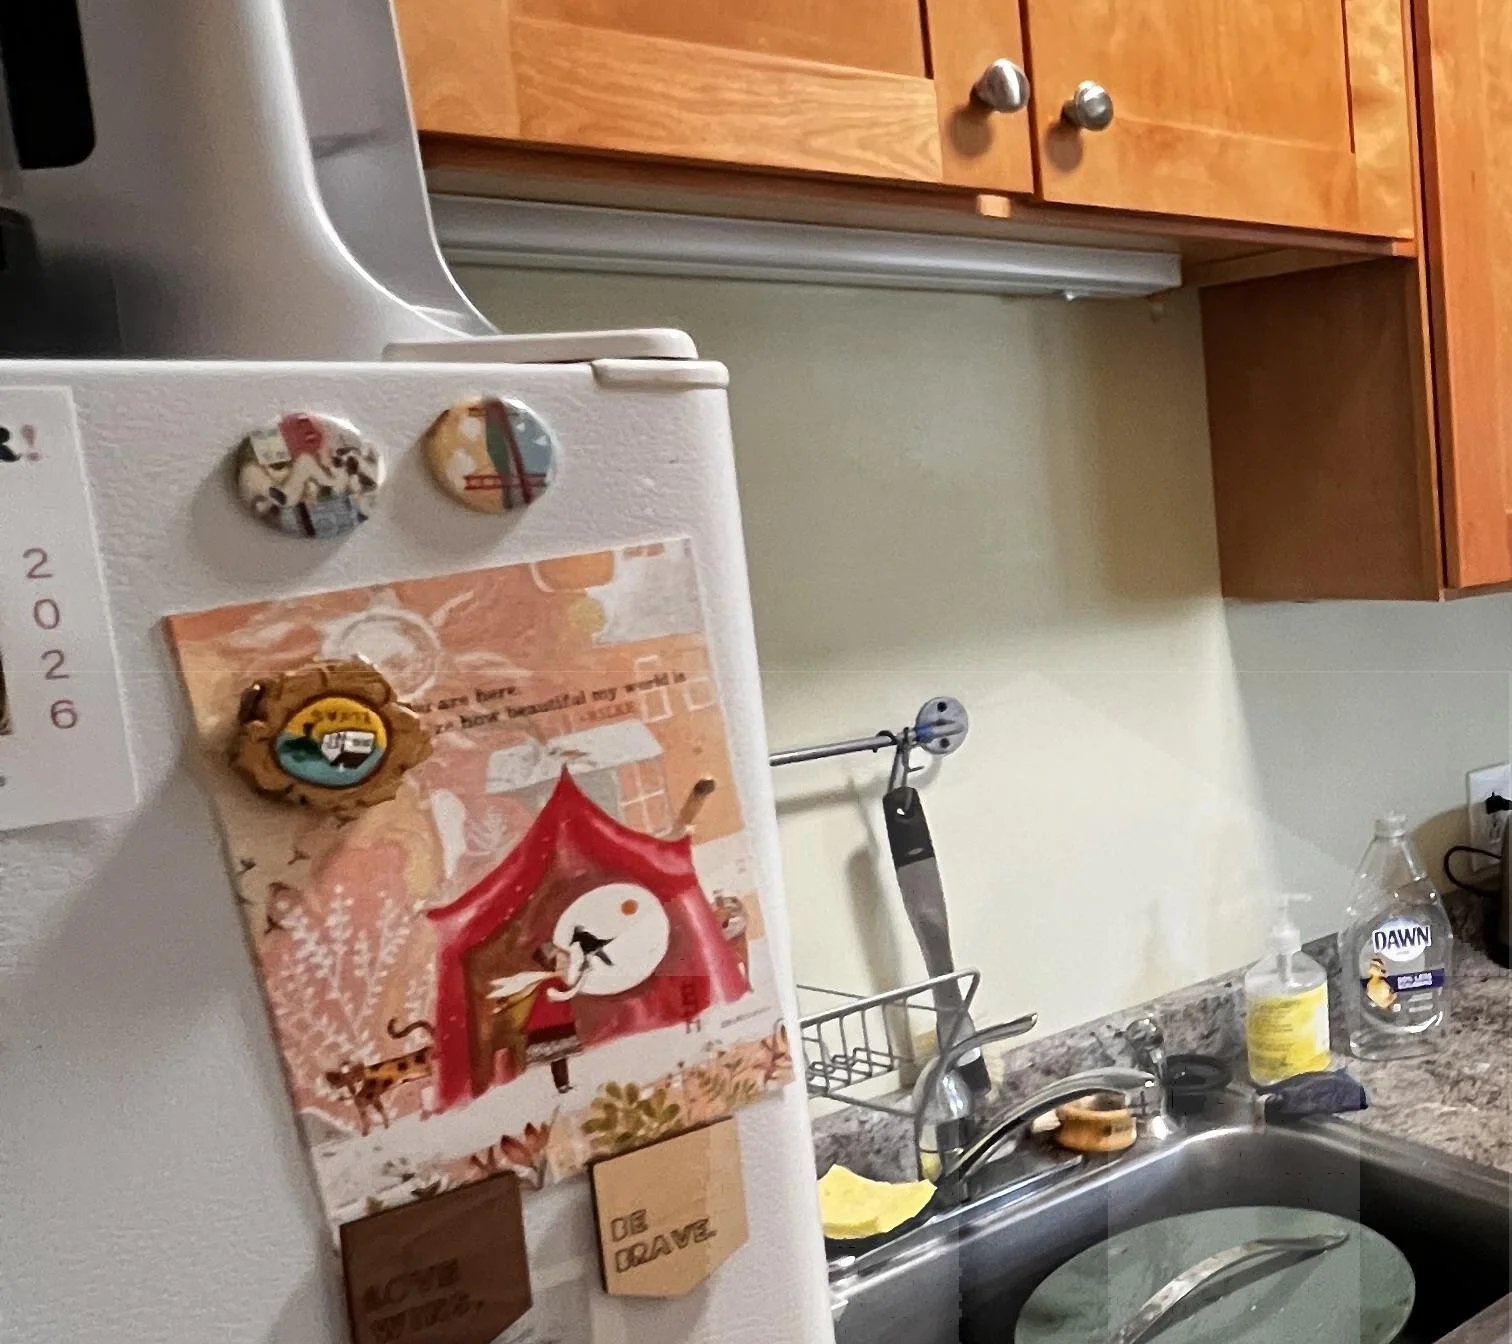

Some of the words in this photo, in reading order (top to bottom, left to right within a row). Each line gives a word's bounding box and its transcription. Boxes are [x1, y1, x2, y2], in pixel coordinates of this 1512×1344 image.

[460, 711, 499, 729] how
[506, 690, 587, 718] beautiful
[592, 688, 617, 702] my
[1374, 926, 1430, 952] DAWN
[610, 1208, 649, 1243] BE
